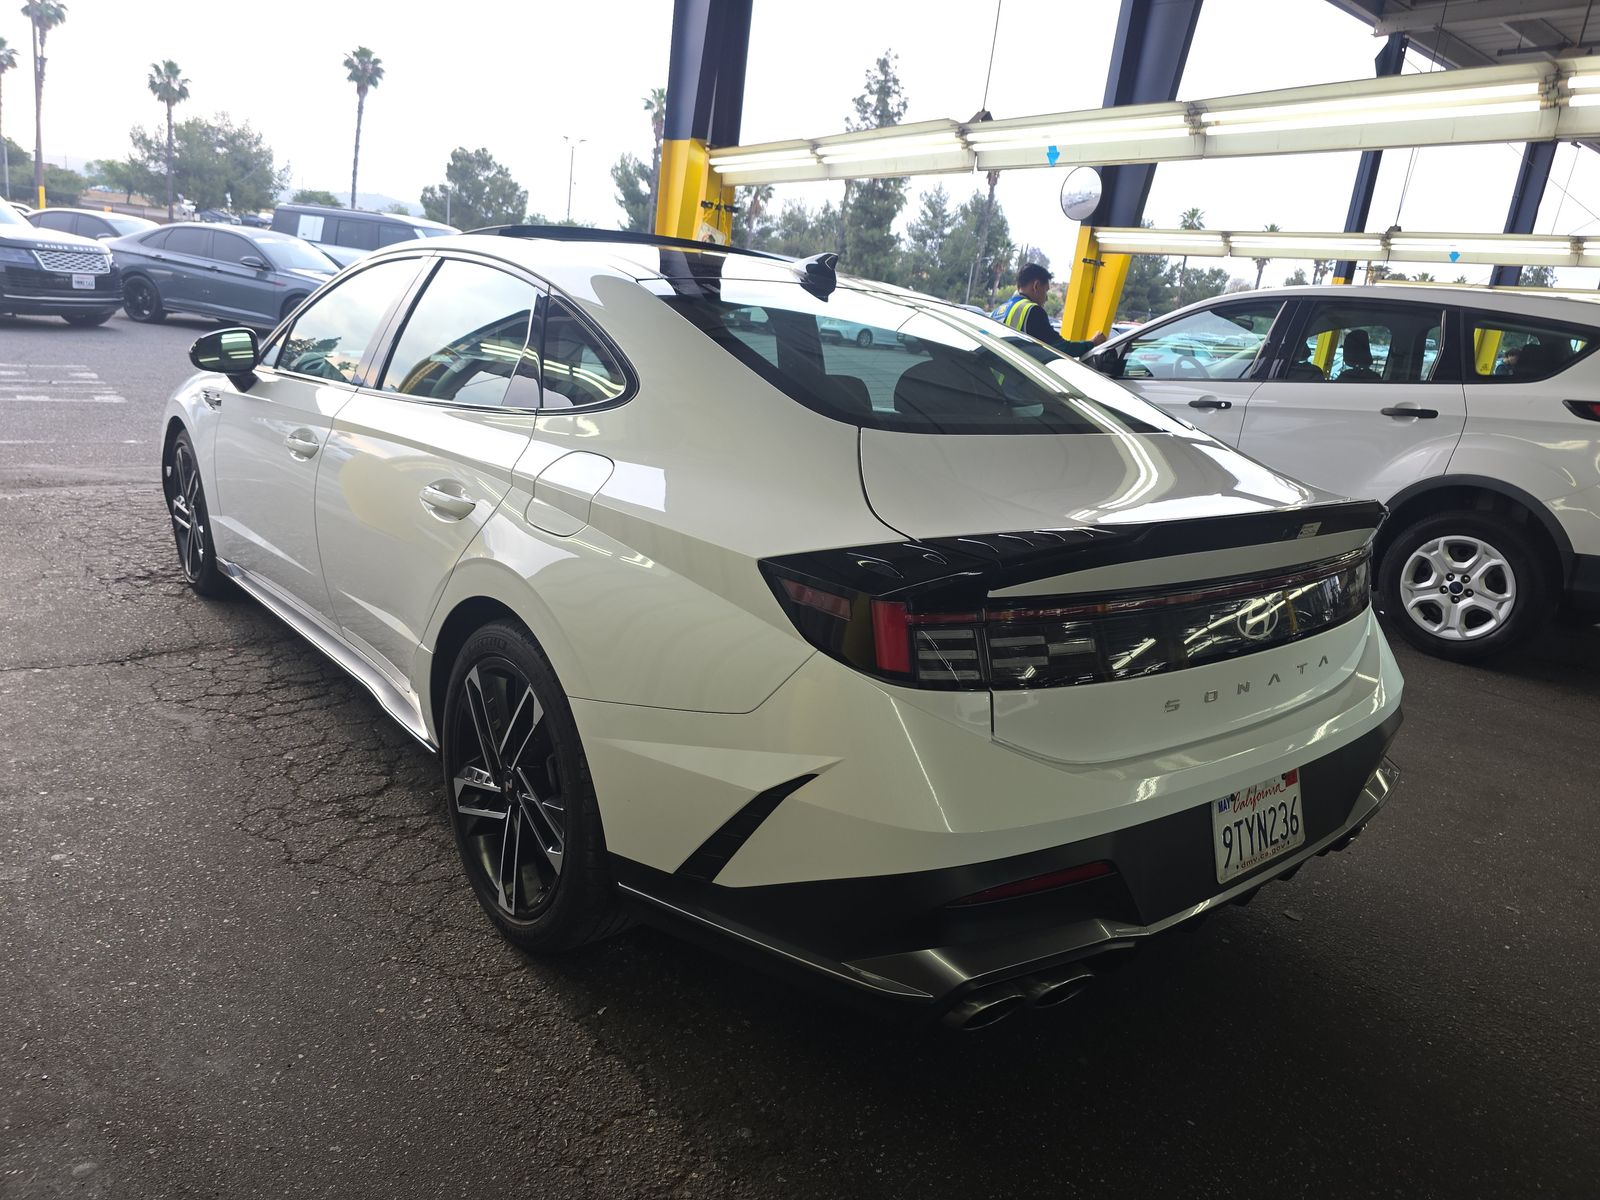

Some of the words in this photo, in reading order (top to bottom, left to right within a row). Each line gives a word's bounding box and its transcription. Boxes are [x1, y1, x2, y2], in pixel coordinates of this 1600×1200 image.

[1163, 654, 1329, 713] SONATA
[1218, 796, 1231, 813] MAY
[1232, 784, 1286, 814] California
[1222, 795, 1300, 870] 9TYN236
[1240, 844, 1286, 869] dmv.ca.gov
